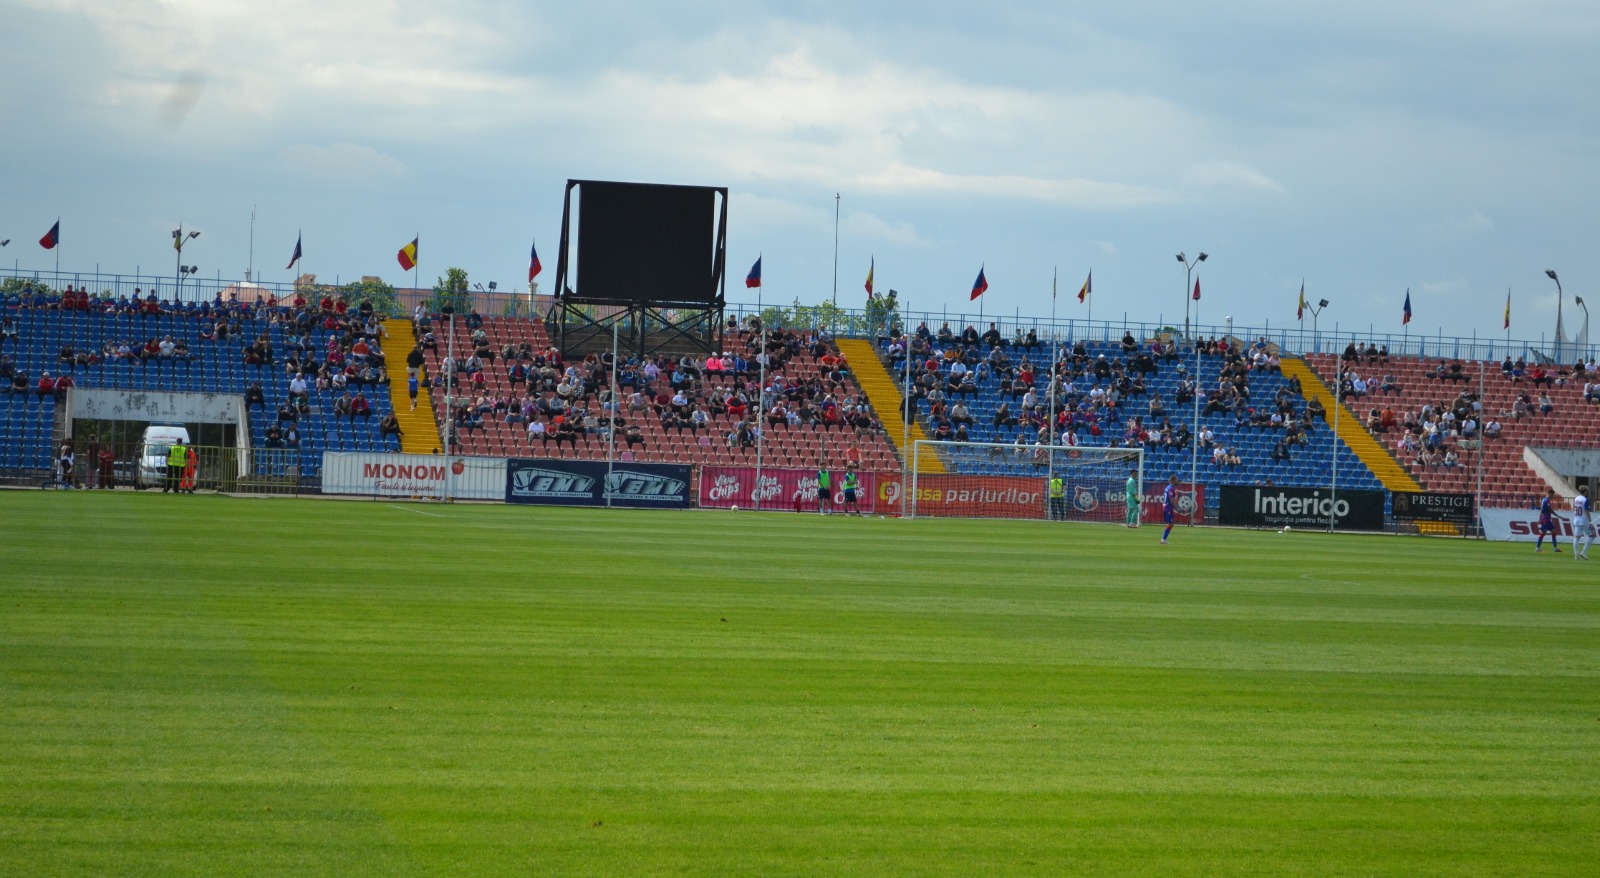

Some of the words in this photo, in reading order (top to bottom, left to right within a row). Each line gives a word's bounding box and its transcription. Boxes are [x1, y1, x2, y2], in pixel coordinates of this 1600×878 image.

[364, 464, 446, 480] MONOM
[714, 474, 736, 487] Viva
[709, 482, 740, 500] Chips
[751, 484, 782, 501] Chips
[946, 488, 1038, 504] pariurilor
[1254, 488, 1349, 516] Interico
[1412, 495, 1470, 507] PRESTIGE
